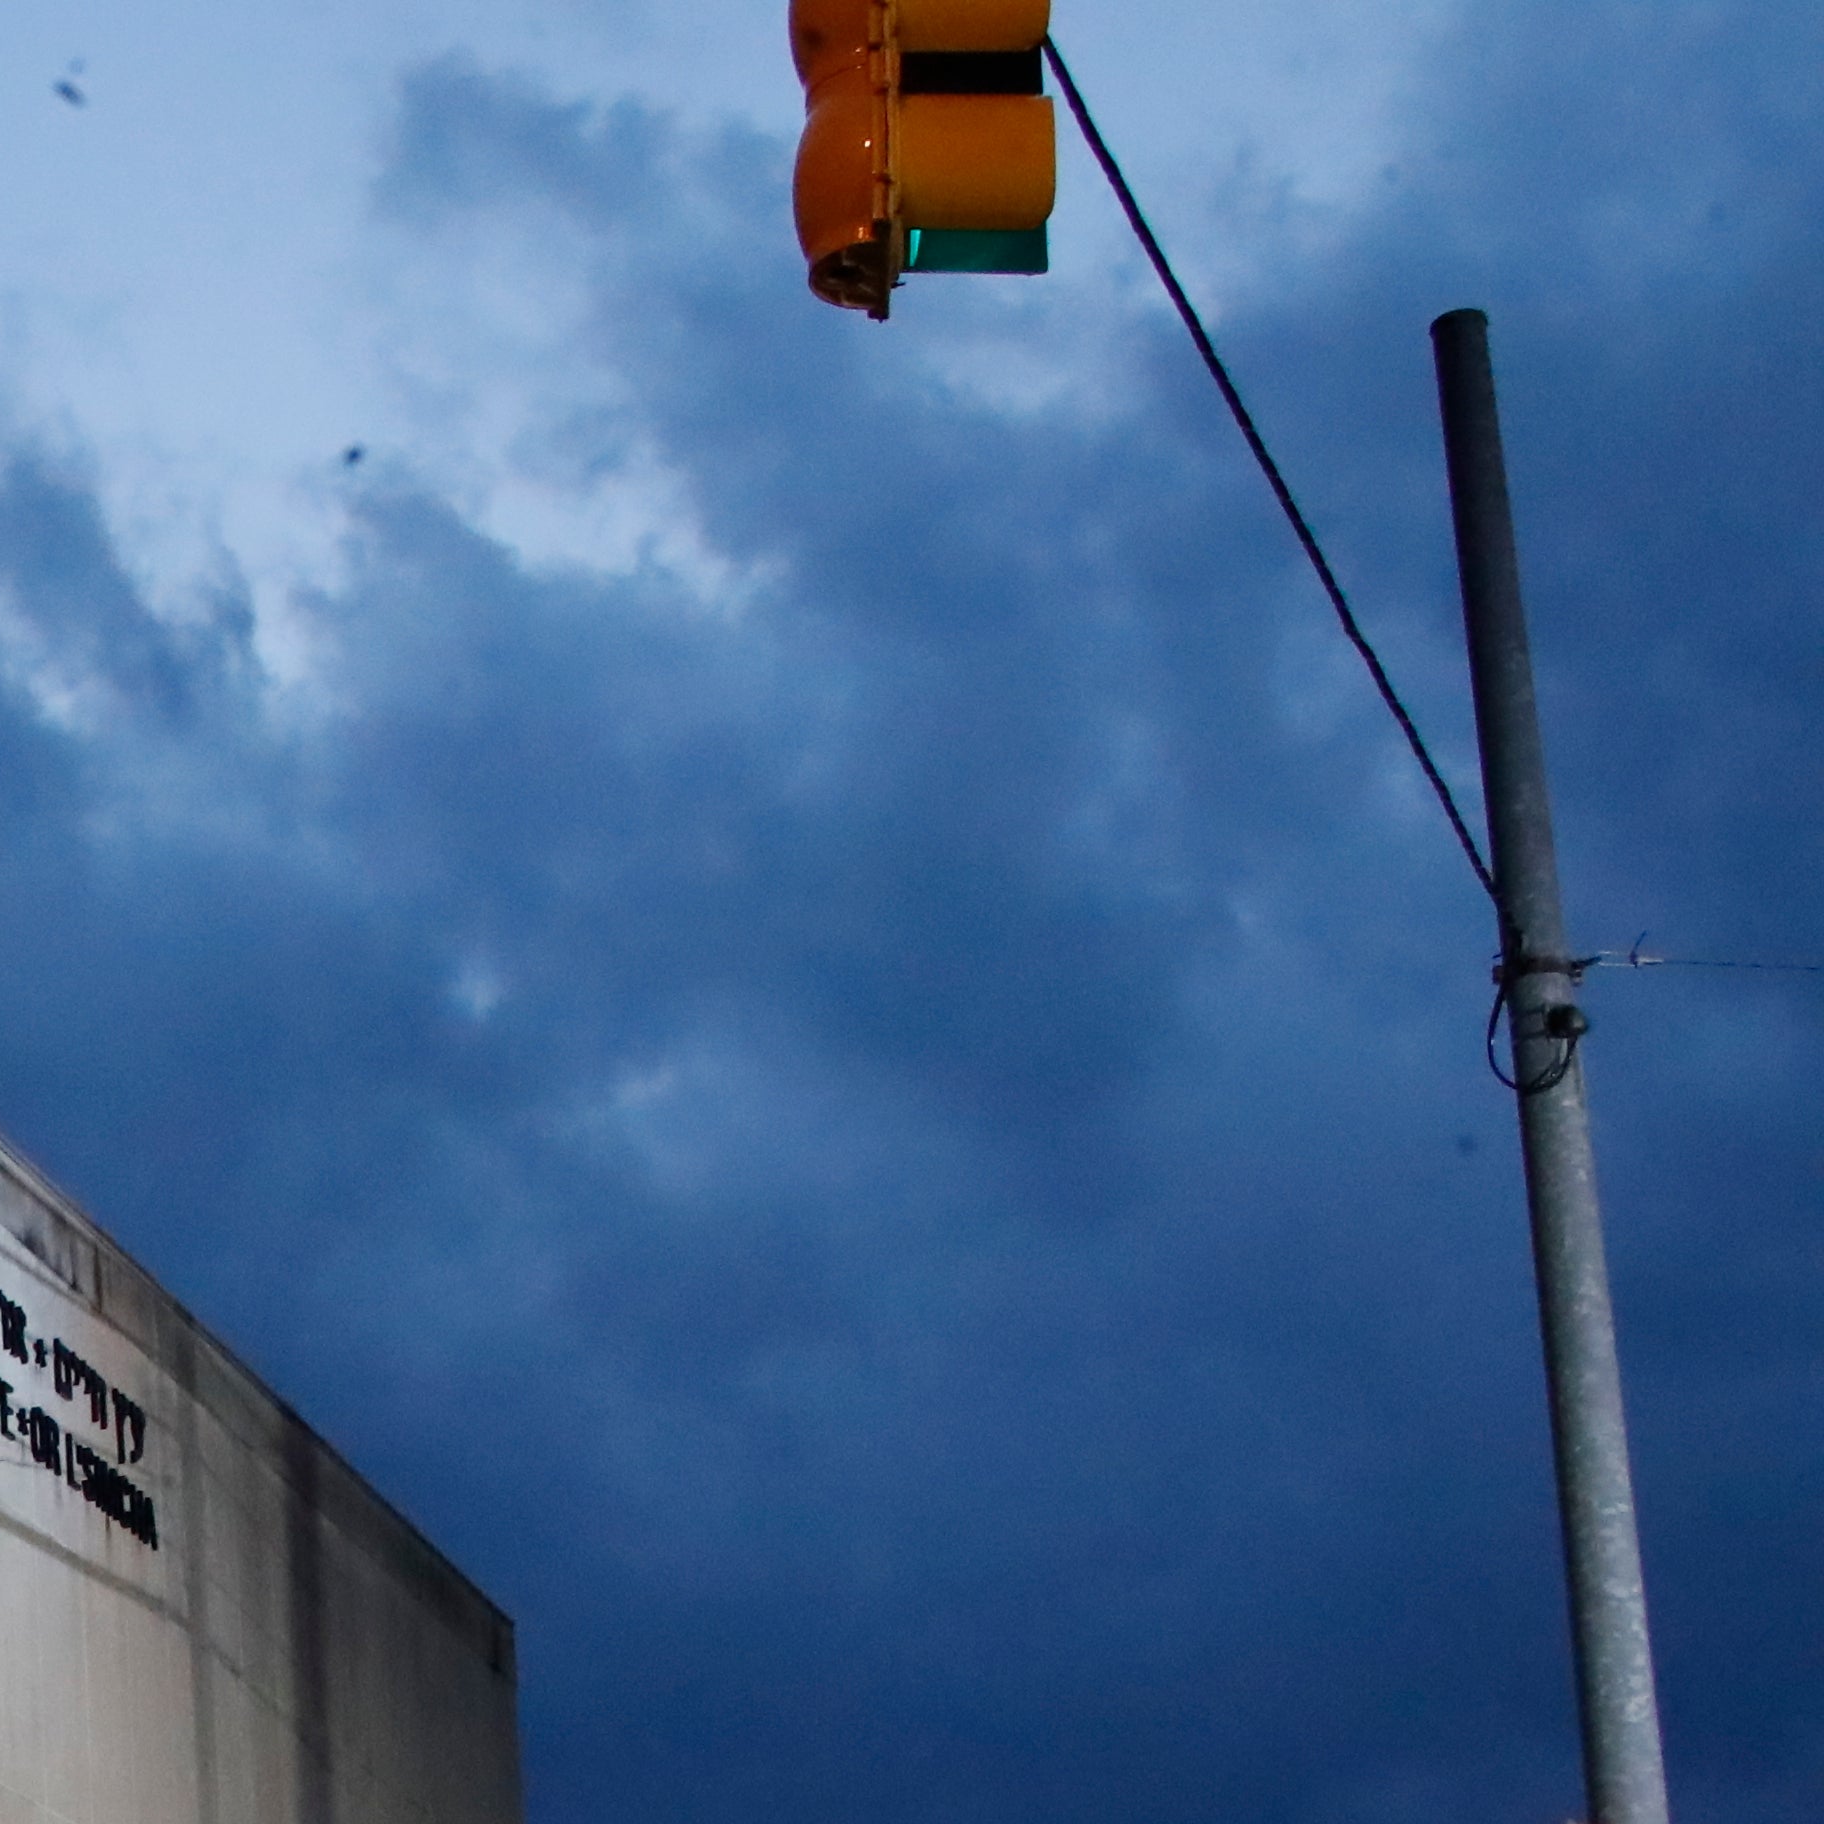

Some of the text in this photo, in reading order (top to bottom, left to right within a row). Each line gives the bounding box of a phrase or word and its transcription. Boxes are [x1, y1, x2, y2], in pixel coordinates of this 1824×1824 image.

[54, 1338, 107, 1430] חיים
[30, 1407, 62, 1476] OR
[112, 1387, 146, 1464] עץ
